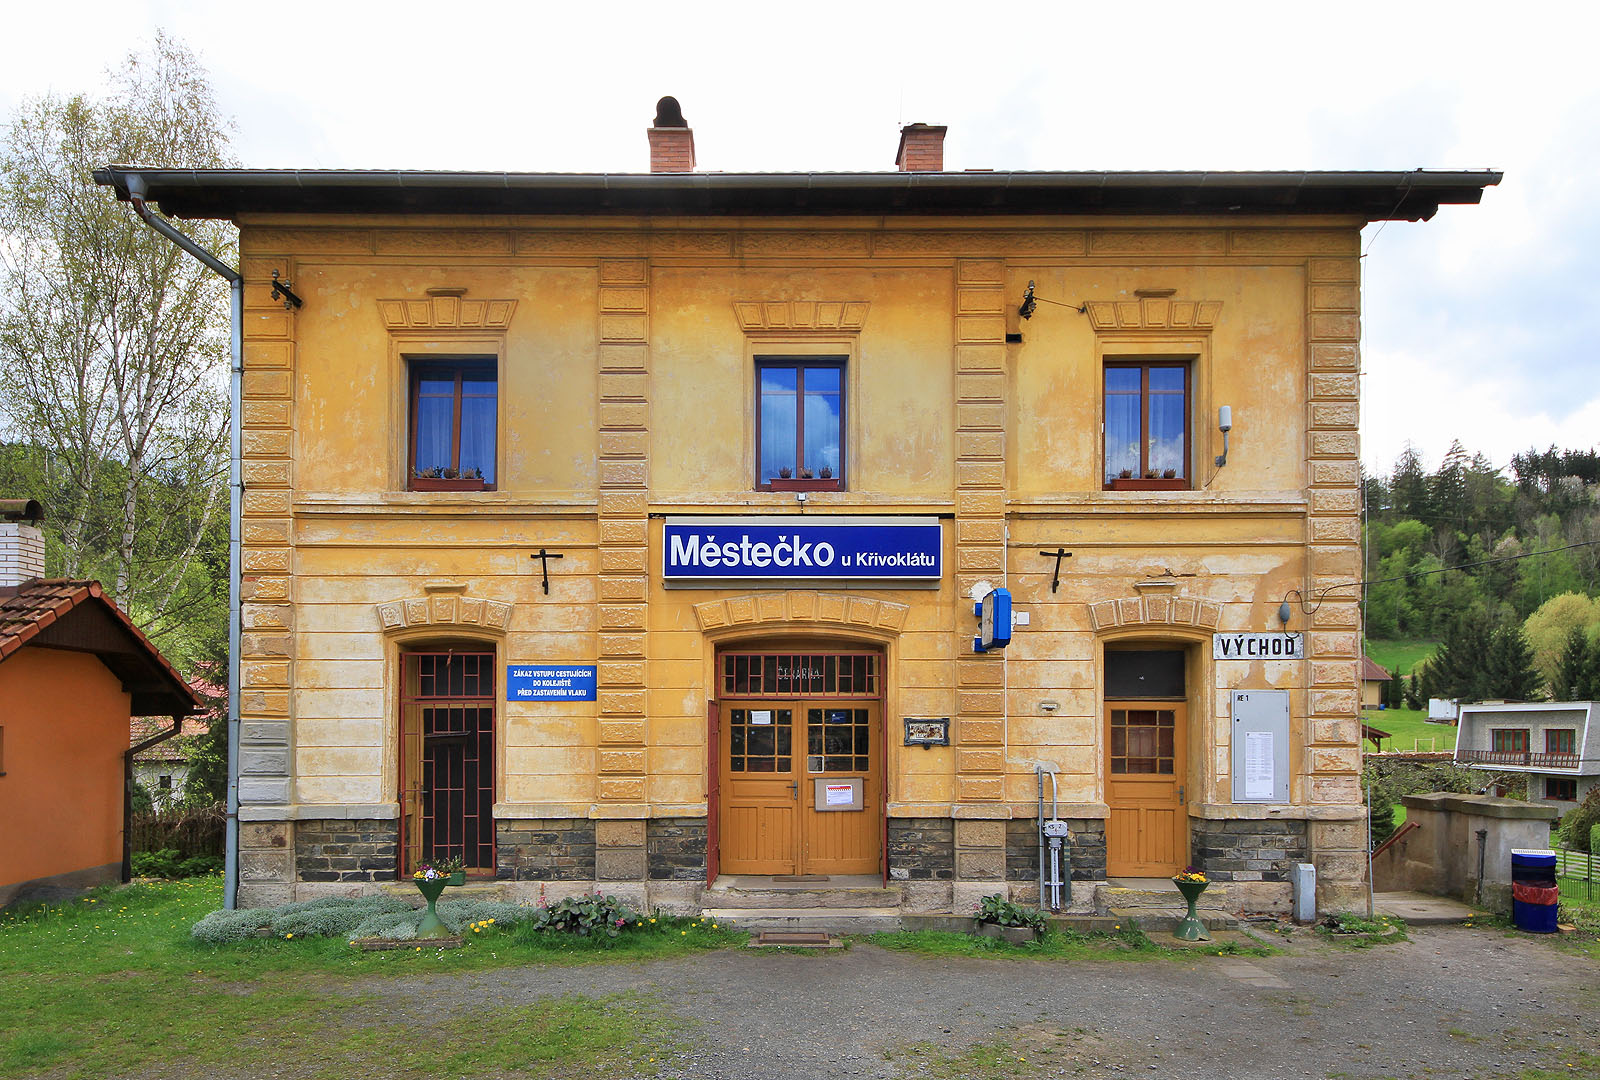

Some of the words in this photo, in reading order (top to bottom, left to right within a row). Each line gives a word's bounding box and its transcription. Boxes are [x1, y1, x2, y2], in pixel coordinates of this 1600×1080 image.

[670, 534, 835, 567] Městečko
[841, 555, 851, 567] u
[856, 552, 935, 567] Křivoklátu
[1220, 634, 1294, 656] VÝCHOD
[513, 669, 532, 678] ZÁKAZ
[533, 670, 555, 678] VSTUPU
[556, 669, 592, 678] CESTUJÍCÍCH
[542, 678, 571, 687] KOLEJIŠTĚ
[517, 688, 532, 696] PŘED
[533, 688, 567, 696] ZASTAVENÍM
